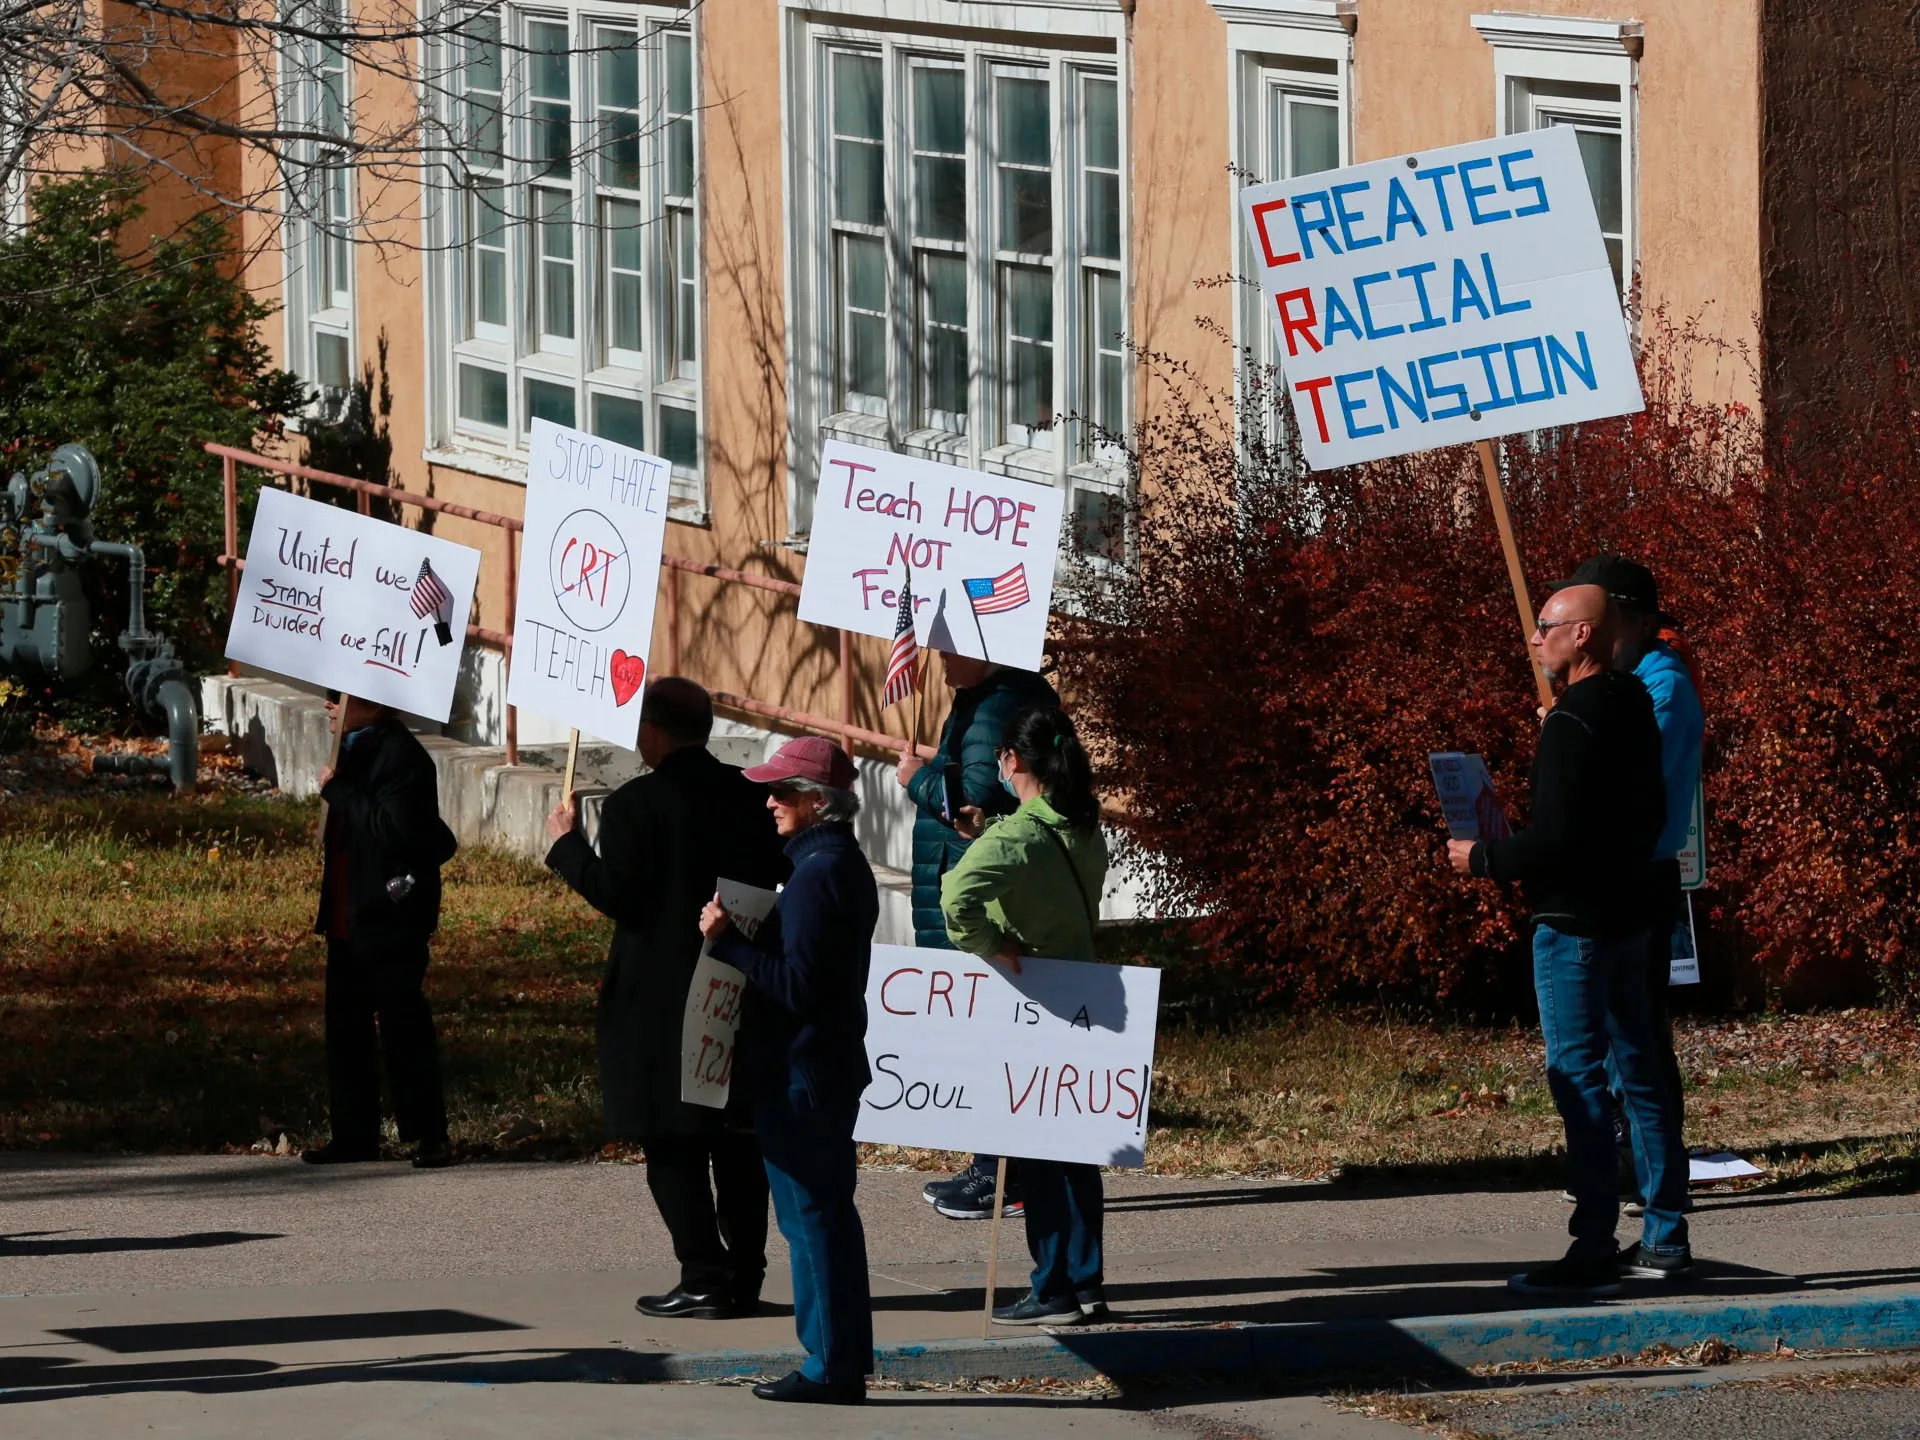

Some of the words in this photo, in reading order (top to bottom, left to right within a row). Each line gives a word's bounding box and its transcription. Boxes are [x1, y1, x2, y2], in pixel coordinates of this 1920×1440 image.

[1251, 148, 1550, 268] CREATES
[1275, 252, 1532, 357] RACIAL
[1294, 330, 1598, 444] TENSION
[549, 432, 604, 490] STOP
[611, 452, 663, 514] HATE
[829, 459, 923, 523] Teach
[943, 487, 1036, 547] HOPE
[278, 527, 358, 579] United
[376, 566, 411, 591] we
[560, 537, 618, 608] CRT
[886, 532, 952, 571] NOT
[852, 569, 931, 614] Fer
[340, 632, 367, 651] we
[525, 619, 608, 699] TEACH
[880, 967, 989, 1018] CRT
[1014, 1001, 1040, 1025] IS
[1070, 1004, 1091, 1031] A
[1004, 1061, 1150, 1136] VIRUS!
